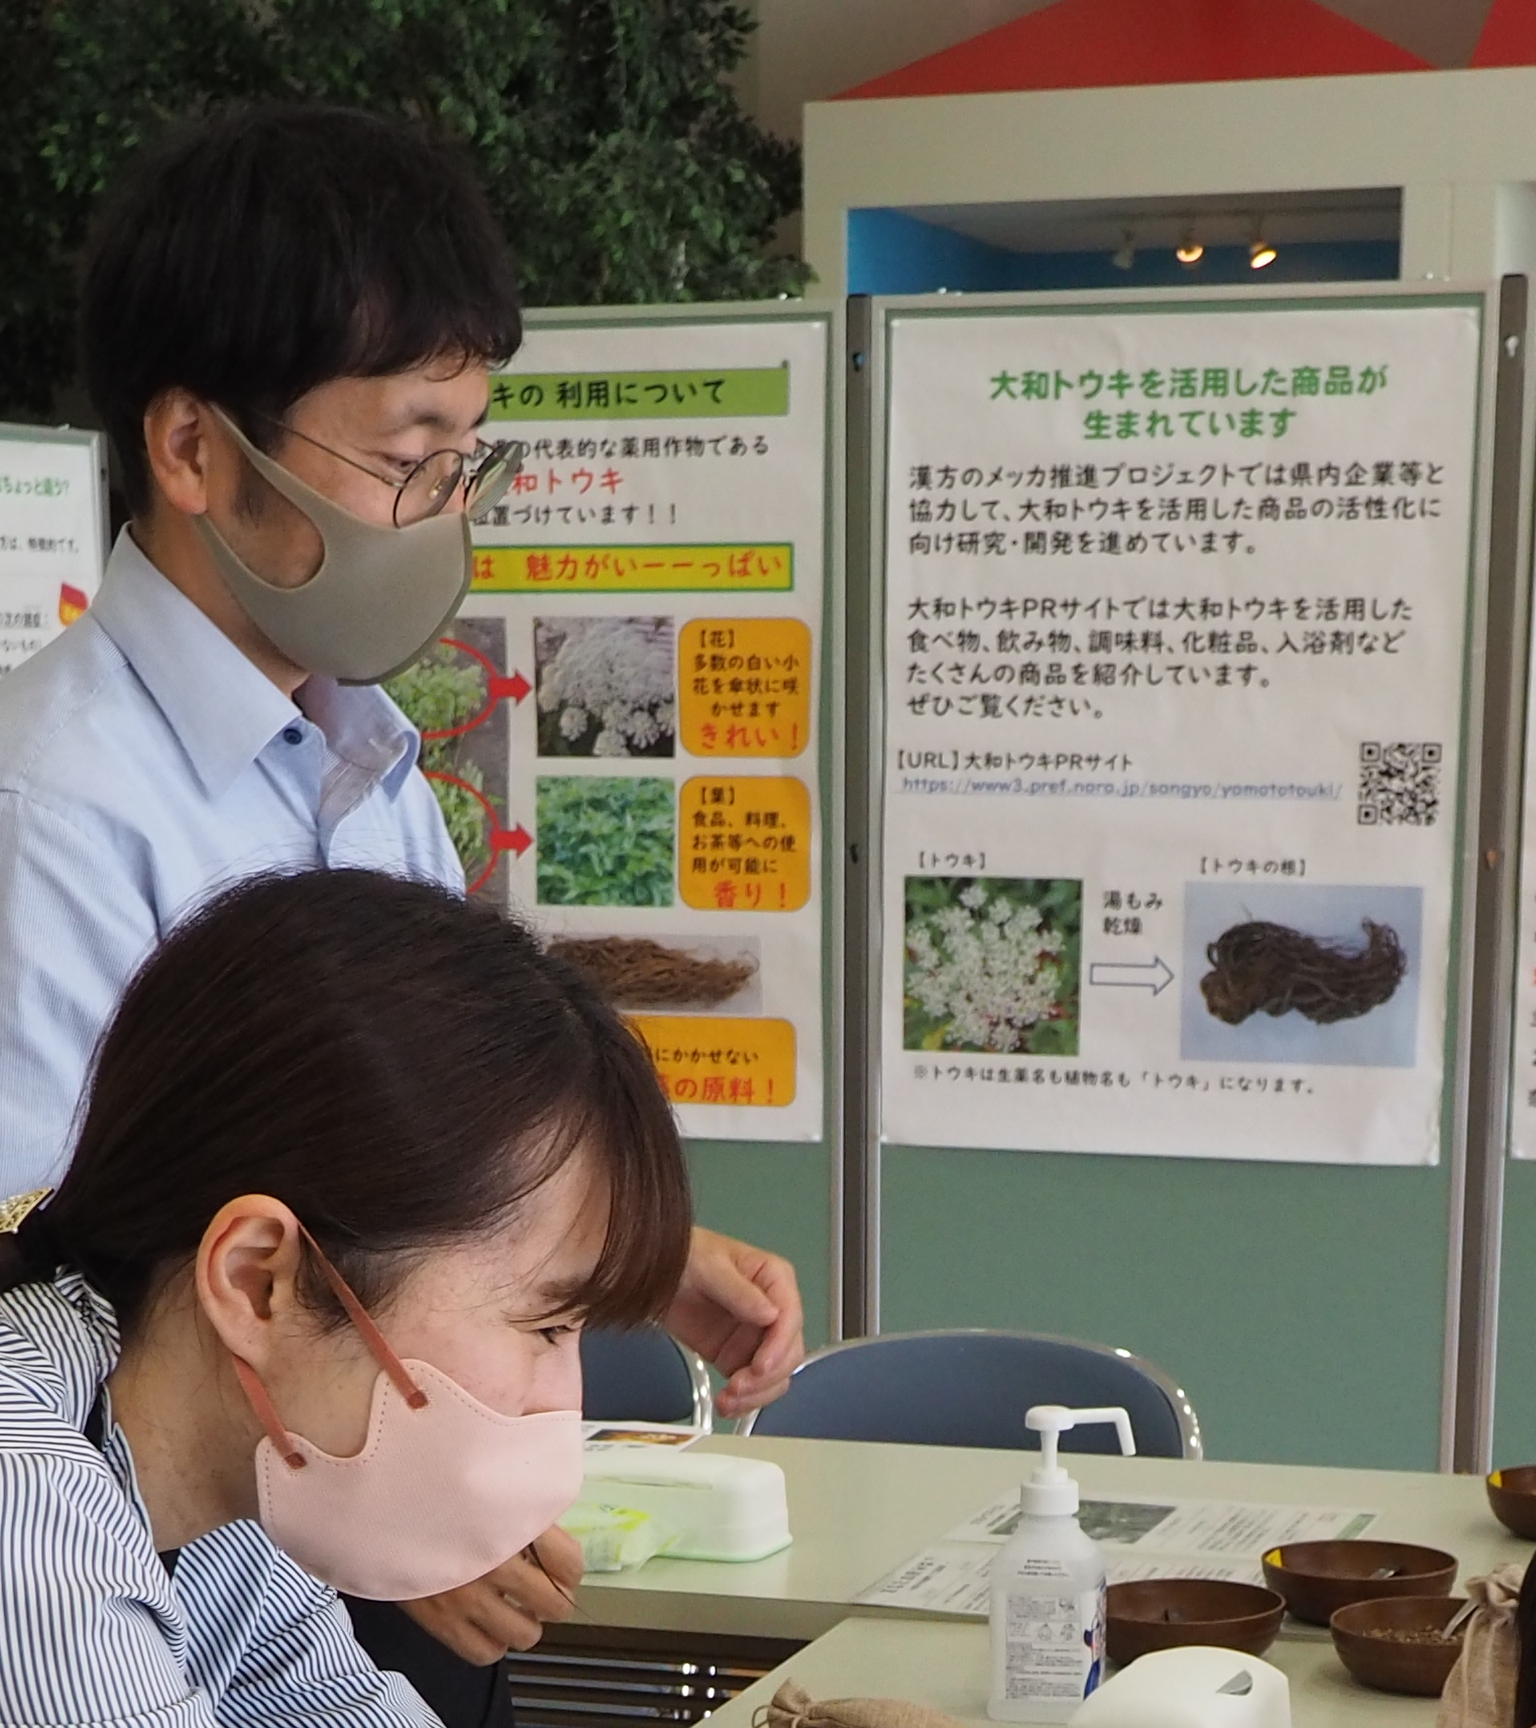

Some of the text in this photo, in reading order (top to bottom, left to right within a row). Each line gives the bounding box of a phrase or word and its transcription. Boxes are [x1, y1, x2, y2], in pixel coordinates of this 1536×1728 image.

[556, 377, 727, 410] 利用について
[988, 363, 1390, 402] 大和トウキを活用した商品が
[1082, 407, 1299, 442] 生まれています
[502, 466, 625, 496] 和トウキ
[908, 460, 1447, 491] 漢方のメッカ推進プロジェクトでは県内企業等と
[908, 495, 1442, 524] 協力して、大和トウキを活用した商品の活性化に
[908, 530, 1260, 558] 向け研究・開発を進めています。
[906, 596, 1414, 625] 大和トウキPRサイトでは大和トウキを活用した
[906, 627, 1406, 657] 食べ物、飲み物、調味料、化粧品、入浴剤など
[905, 662, 1272, 690] たくさんの商品を紹介しています。
[905, 695, 1107, 722] ぜひご覧ください。
[700, 721, 799, 751] きれい！
[714, 880, 786, 908] 香り！
[1102, 891, 1164, 911] 湯もみ
[1102, 915, 1145, 936] 乾燥
